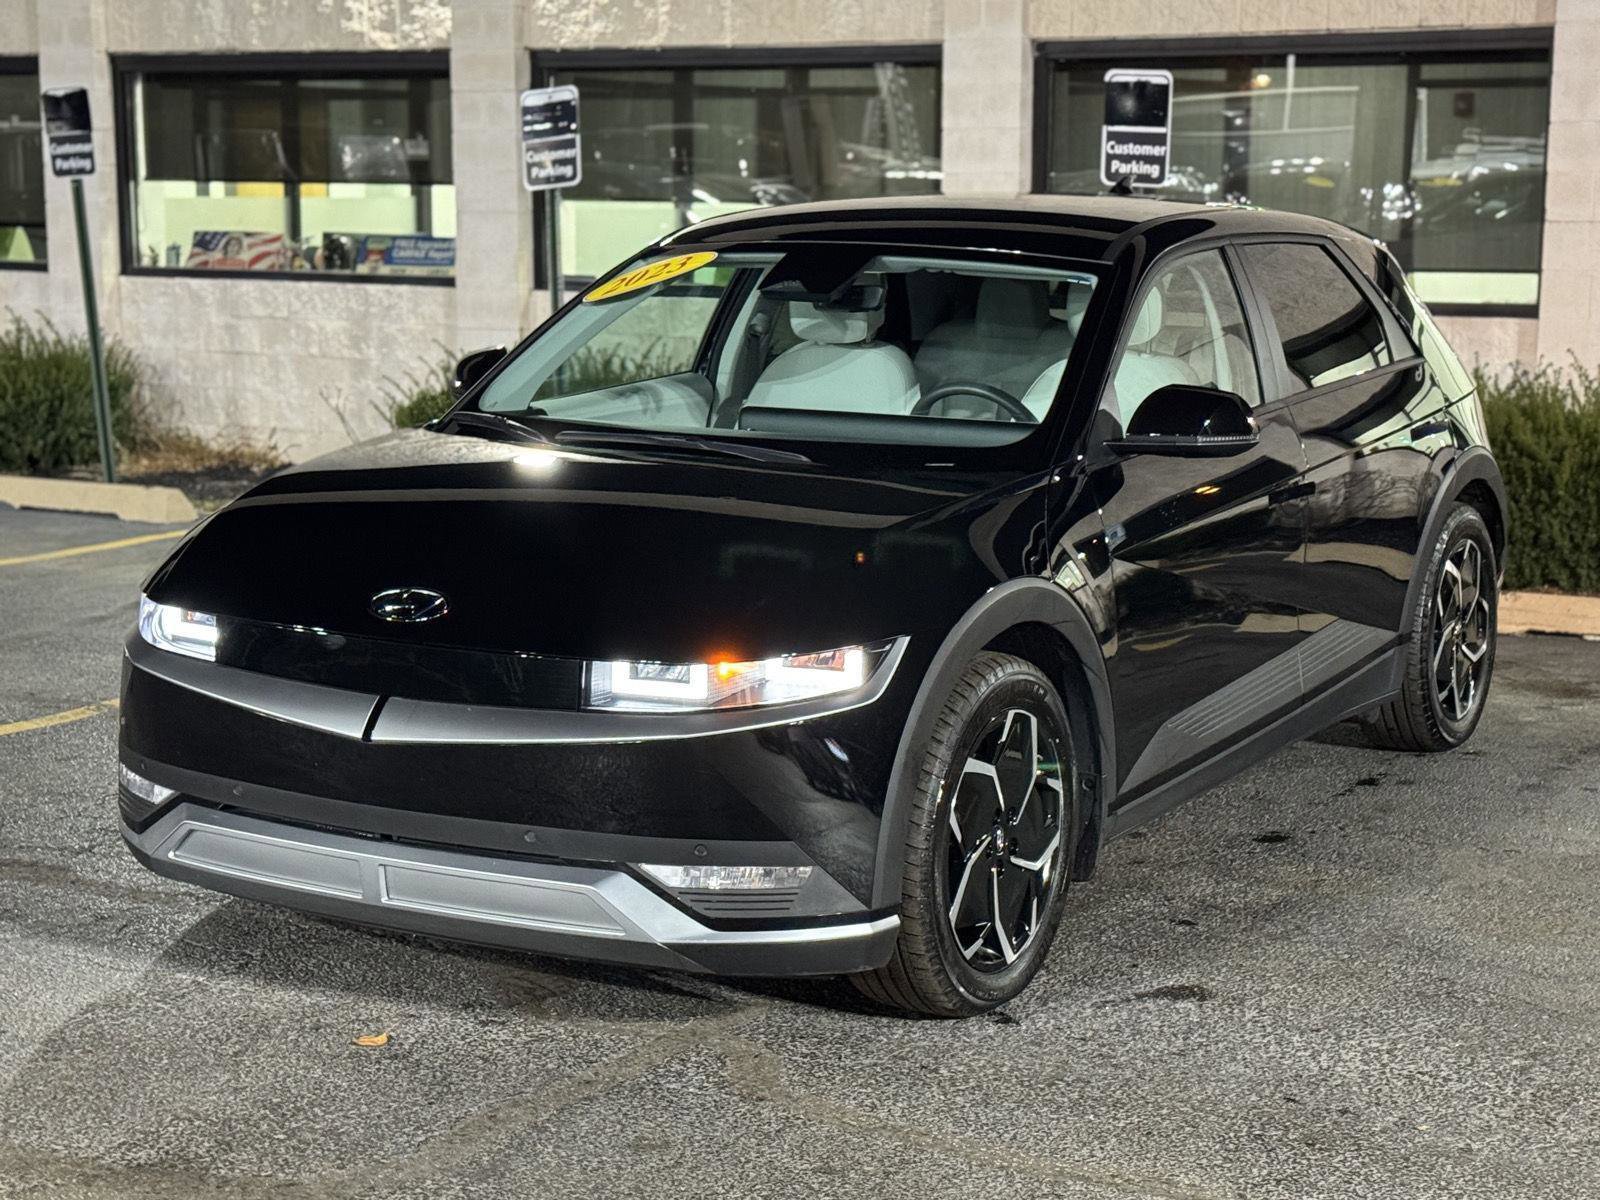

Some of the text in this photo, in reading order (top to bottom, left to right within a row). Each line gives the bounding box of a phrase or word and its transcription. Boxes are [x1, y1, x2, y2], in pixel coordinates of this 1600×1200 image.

[1106, 141, 1167, 156] Customer
[1111, 160, 1160, 178] Parking
[600, 255, 693, 296] 2023
